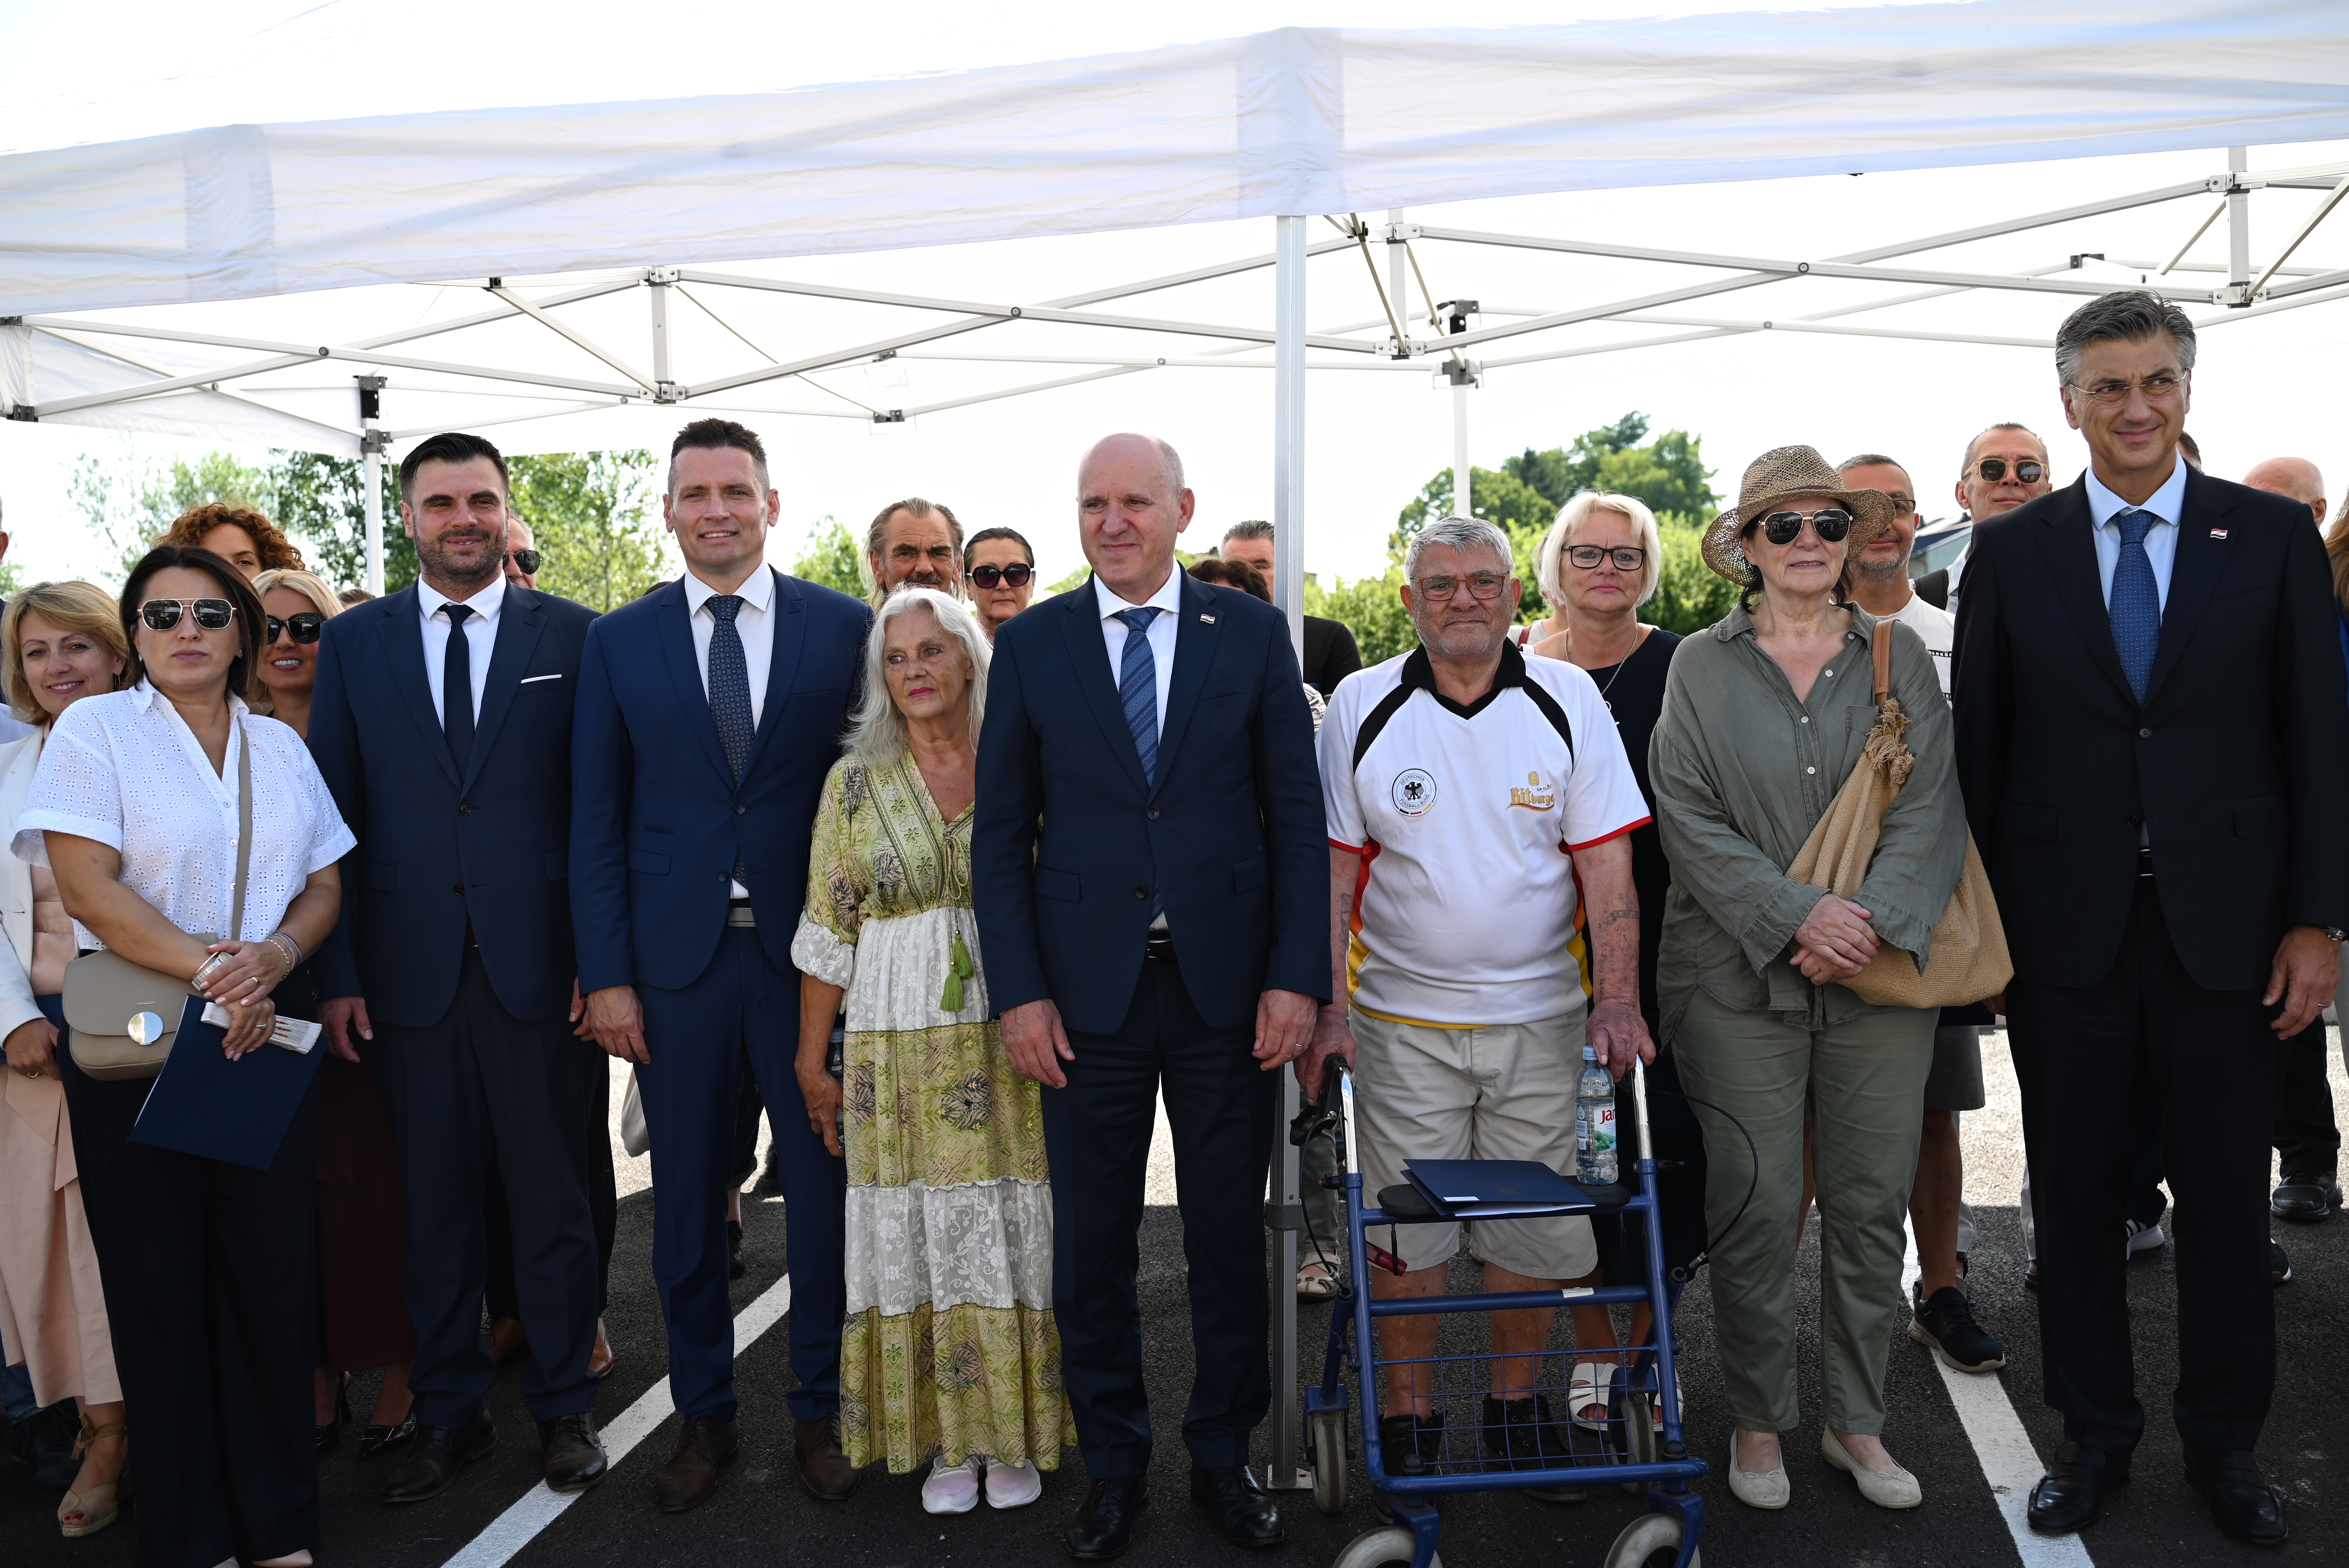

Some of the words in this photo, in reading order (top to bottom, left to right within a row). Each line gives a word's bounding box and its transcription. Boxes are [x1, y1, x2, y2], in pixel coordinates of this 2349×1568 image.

[1400, 775, 1425, 785] DEUTSCHER
[1400, 794, 1429, 808] FUSSBALL-BUND
[1510, 787, 1554, 806] Bitburge
